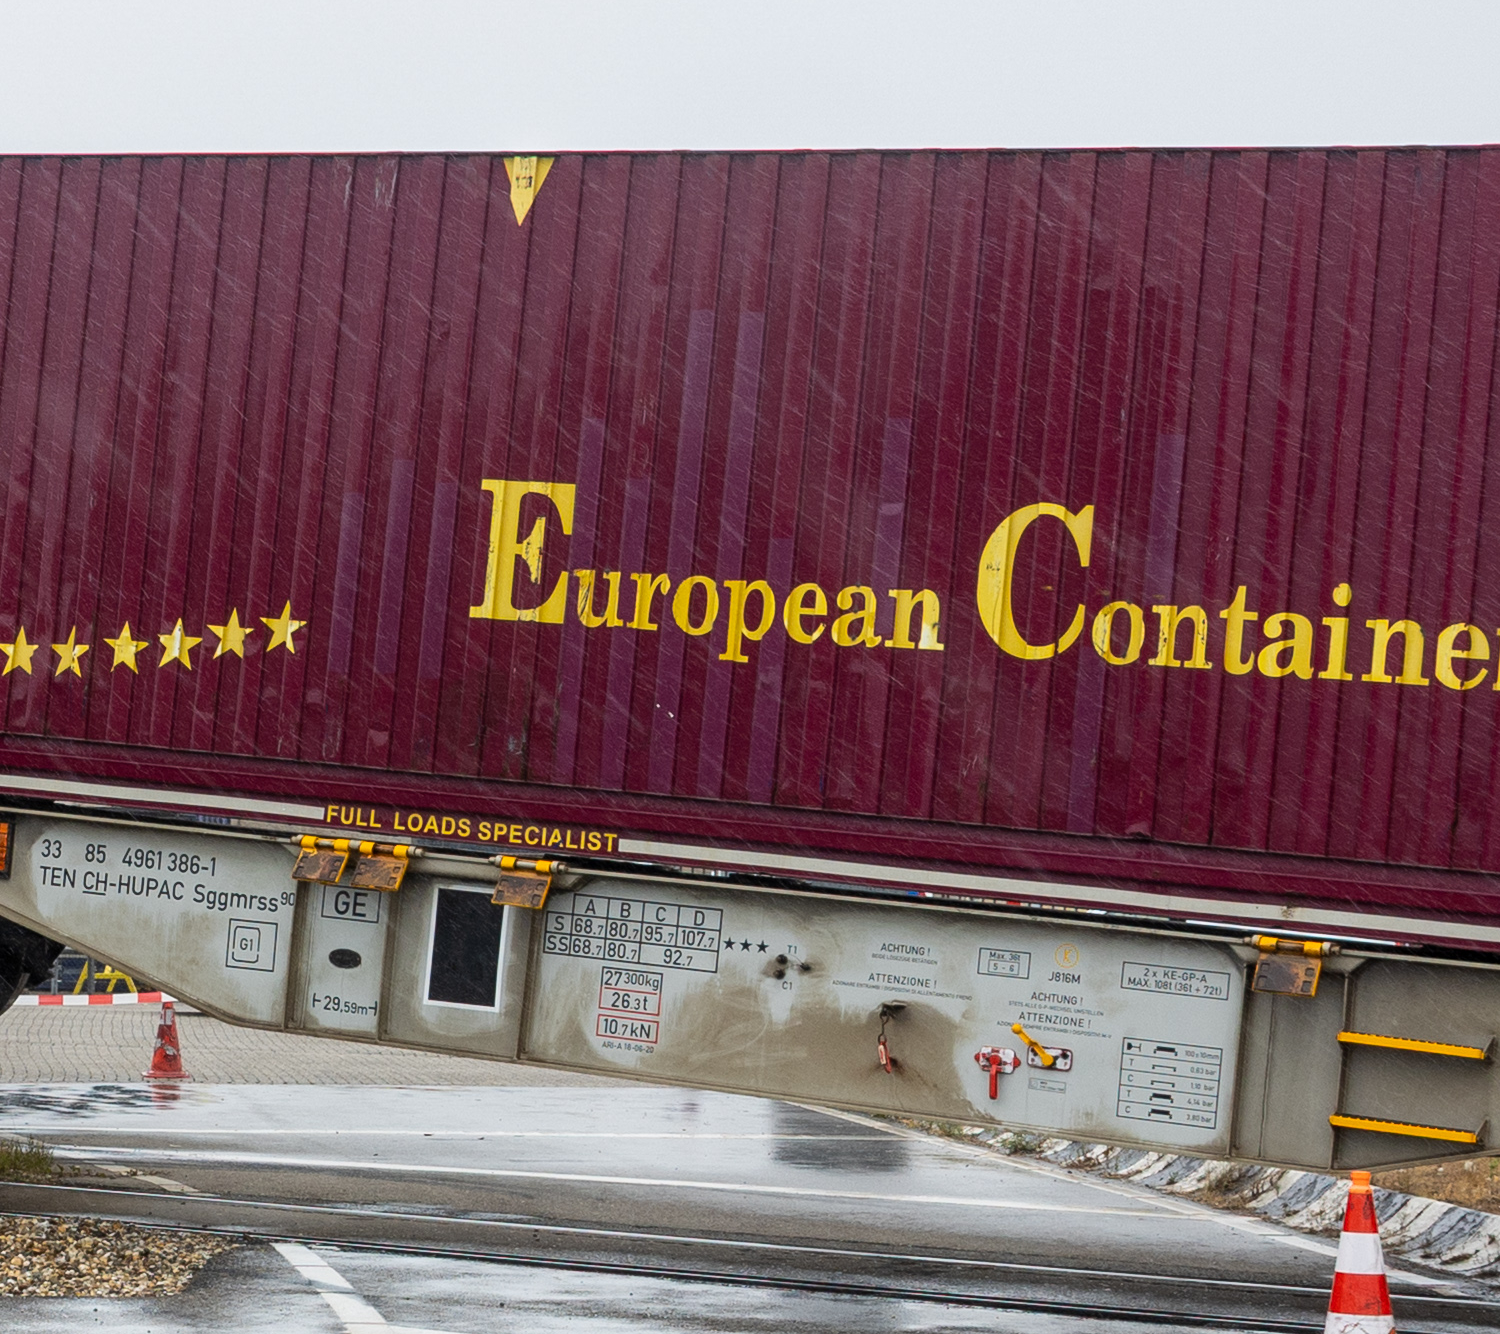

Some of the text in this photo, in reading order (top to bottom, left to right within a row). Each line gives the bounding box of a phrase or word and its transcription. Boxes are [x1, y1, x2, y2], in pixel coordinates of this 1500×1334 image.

[468, 479, 946, 662] European
[326, 805, 617, 852] FULL LOADS SPECIALIST
[41, 839, 217, 876] 33 85 4961 386-1
[40, 866, 76, 888] TEN
[82, 871, 184, 900] CH-HUPAC
[334, 890, 369, 918] GE
[584, 899, 705, 927] A B C D
[554, 915, 715, 948] S 68.7 80.7 95.7 107.7
[239, 938, 253, 951] G1
[546, 935, 693, 968] SS 68.7 80.7 92.7
[787, 944, 797, 954] T1
[880, 942, 925, 956] ACHTUNG
[868, 972, 931, 988] ATTENZIONE
[1048, 971, 1081, 984] J816M
[1143, 968, 1150, 977] 2
[1163, 970, 1207, 983] KE-GP-A
[781, 981, 793, 990] C1
[1031, 991, 1078, 1005] ACHTUNG
[1018, 1011, 1085, 1028] ATTENZIONE
[1127, 1074, 1134, 1082] C
